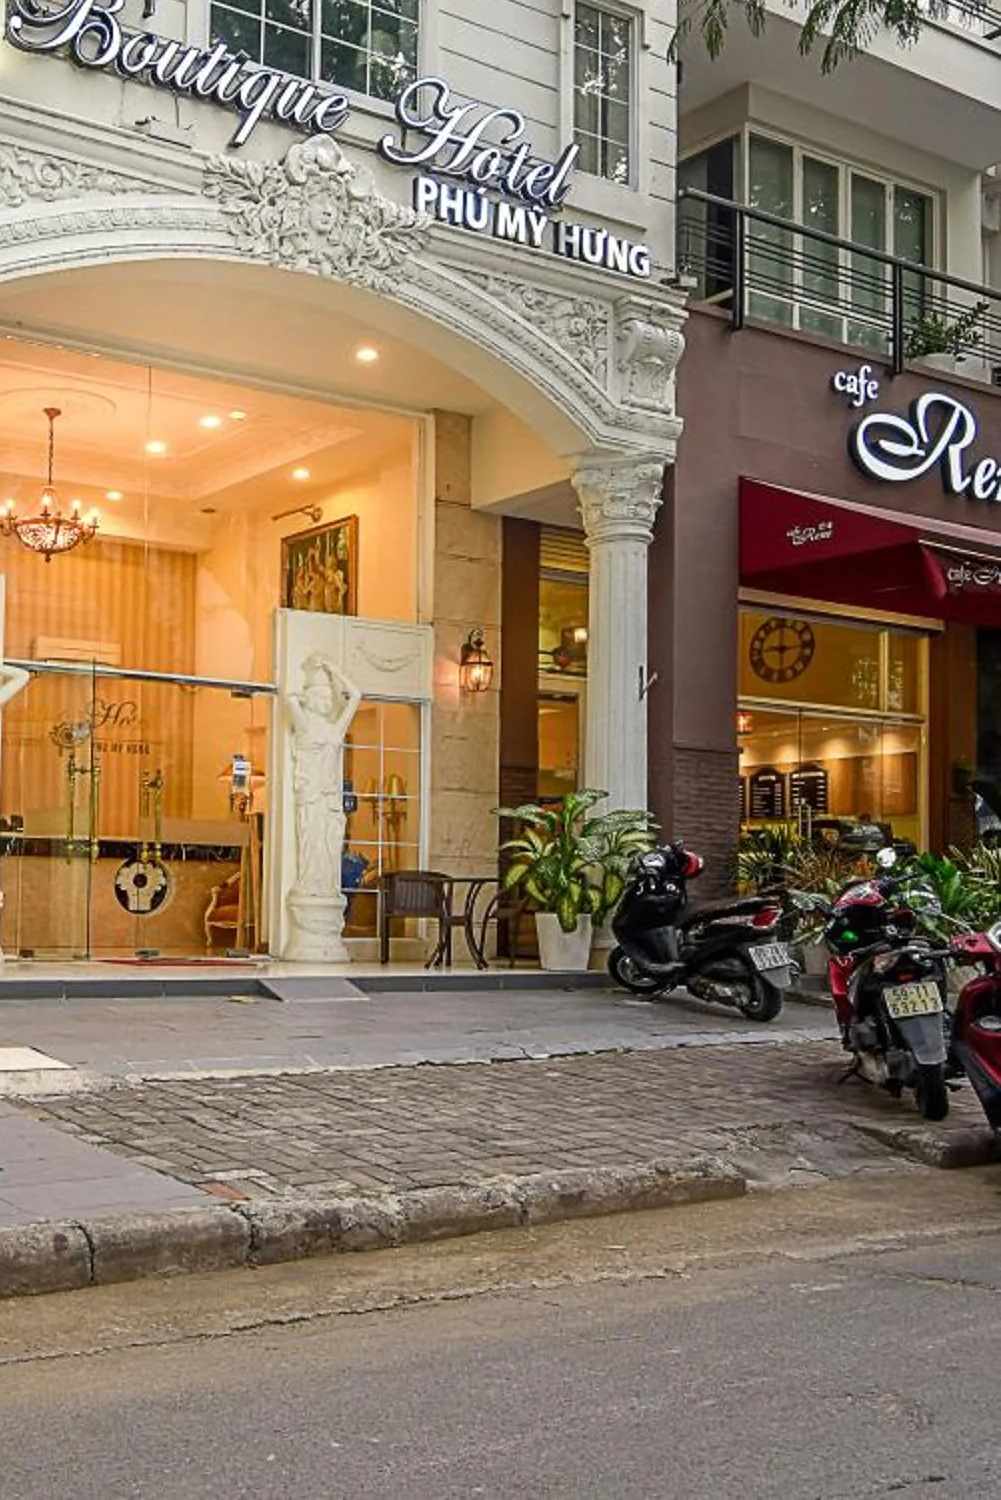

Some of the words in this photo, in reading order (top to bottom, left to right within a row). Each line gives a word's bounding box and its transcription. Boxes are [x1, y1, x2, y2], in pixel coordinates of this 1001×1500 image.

[378, 76, 578, 205] Hotel
[417, 176, 488, 229] PHÚ
[497, 202, 548, 246] MỸ
[559, 221, 651, 278] HƯNG
[834, 364, 879, 407] cafe
[856, 392, 1001, 501] Re
